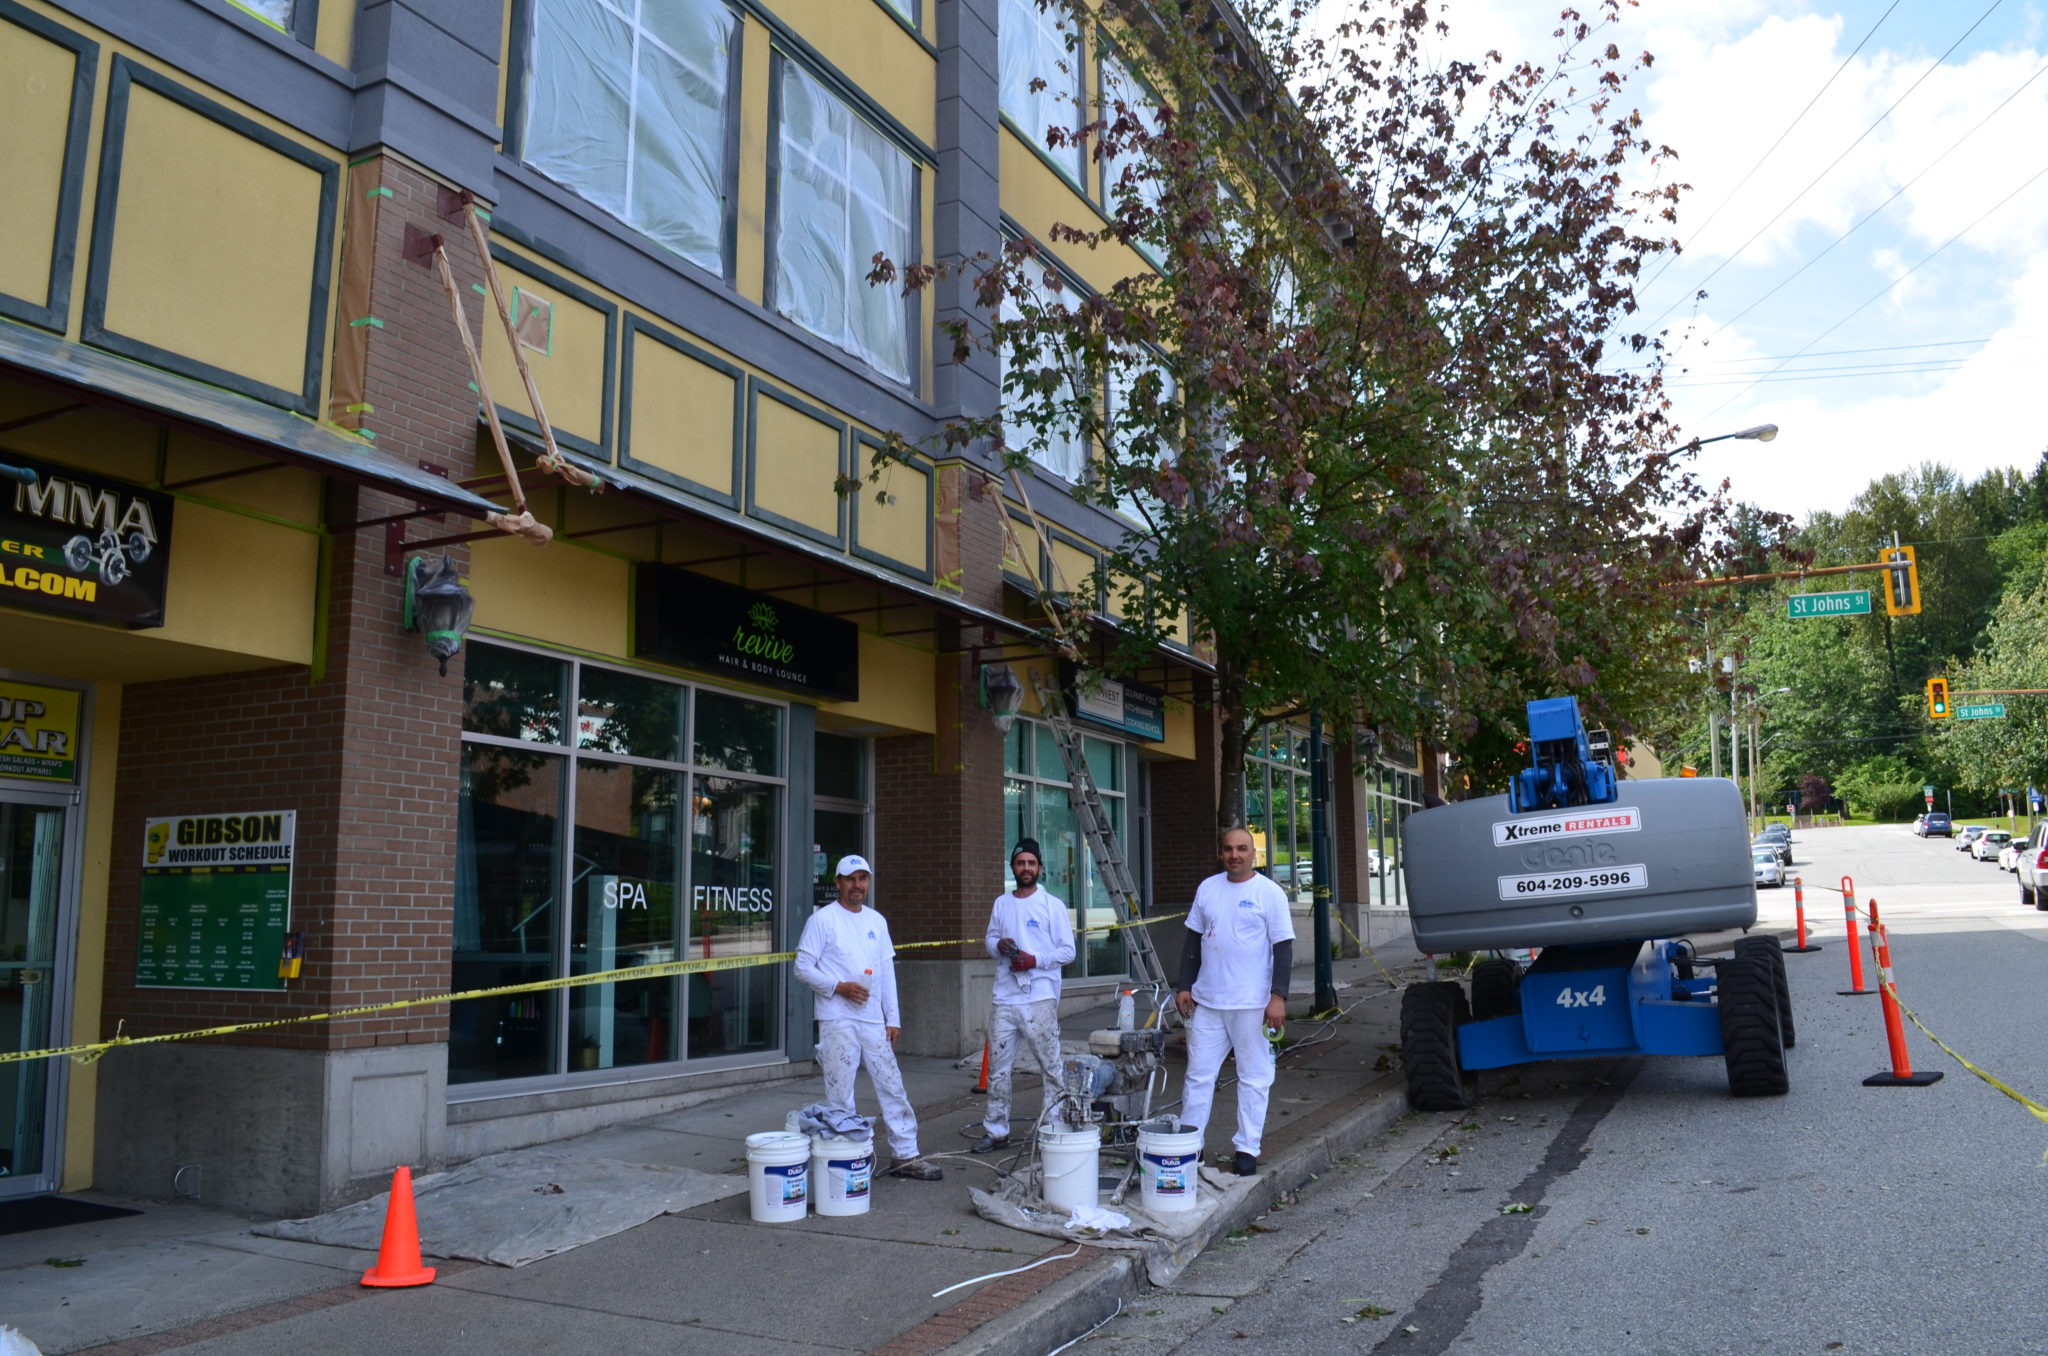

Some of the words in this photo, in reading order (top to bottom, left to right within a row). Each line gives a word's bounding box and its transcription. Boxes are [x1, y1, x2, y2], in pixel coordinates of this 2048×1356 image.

[15, 471, 158, 544] MMA
[1794, 598, 1807, 613] St
[1811, 596, 1850, 612] Johns
[1855, 595, 1864, 605] St
[733, 624, 795, 664] revive
[719, 653, 739, 667] HAIR
[742, 659, 749, 669] &
[751, 662, 773, 675] BODY
[776, 668, 807, 684] LOUNGE
[1960, 707, 1968, 717] St
[1971, 706, 1993, 717] Johns
[177, 814, 282, 846] GIBSON
[1504, 822, 1562, 841] Xtreme
[1569, 816, 1628, 831] RENTALS
[168, 848, 227, 863] WORKOUT
[229, 845, 291, 861] SCHEDULE
[1516, 871, 1631, 893] 604-209-5996
[603, 881, 648, 910] SPA
[693, 885, 773, 912] FITNESS
[1556, 984, 1607, 1008] 4x4
